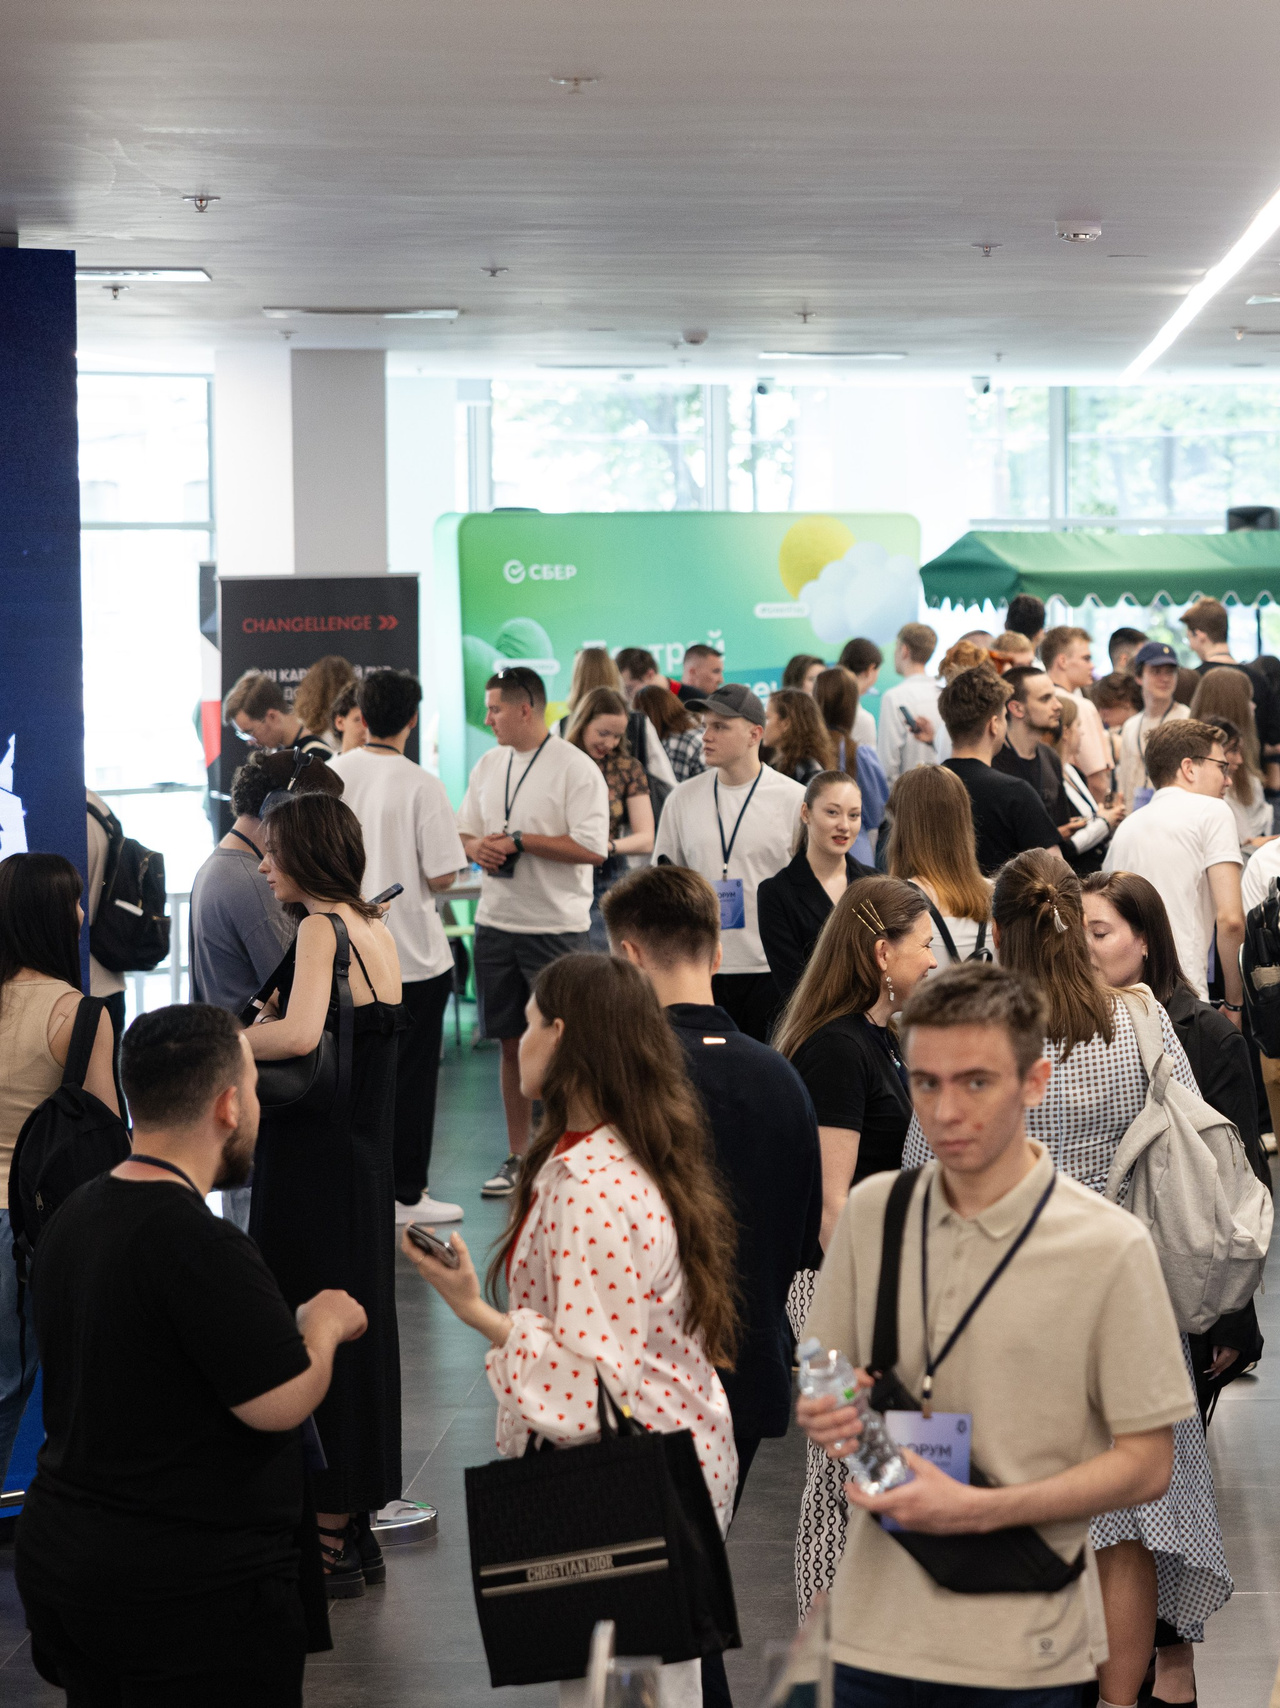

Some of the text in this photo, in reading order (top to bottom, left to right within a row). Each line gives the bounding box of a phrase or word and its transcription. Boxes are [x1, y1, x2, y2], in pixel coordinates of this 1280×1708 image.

[528, 564, 577, 580] СБЕР
[242, 615, 372, 633] CHANGELLENGE
[717, 891, 736, 899] ОРУМ
[905, 1443, 952, 1457] ОРУМ
[527, 1554, 615, 1582] CHRISTIAN DIOR
